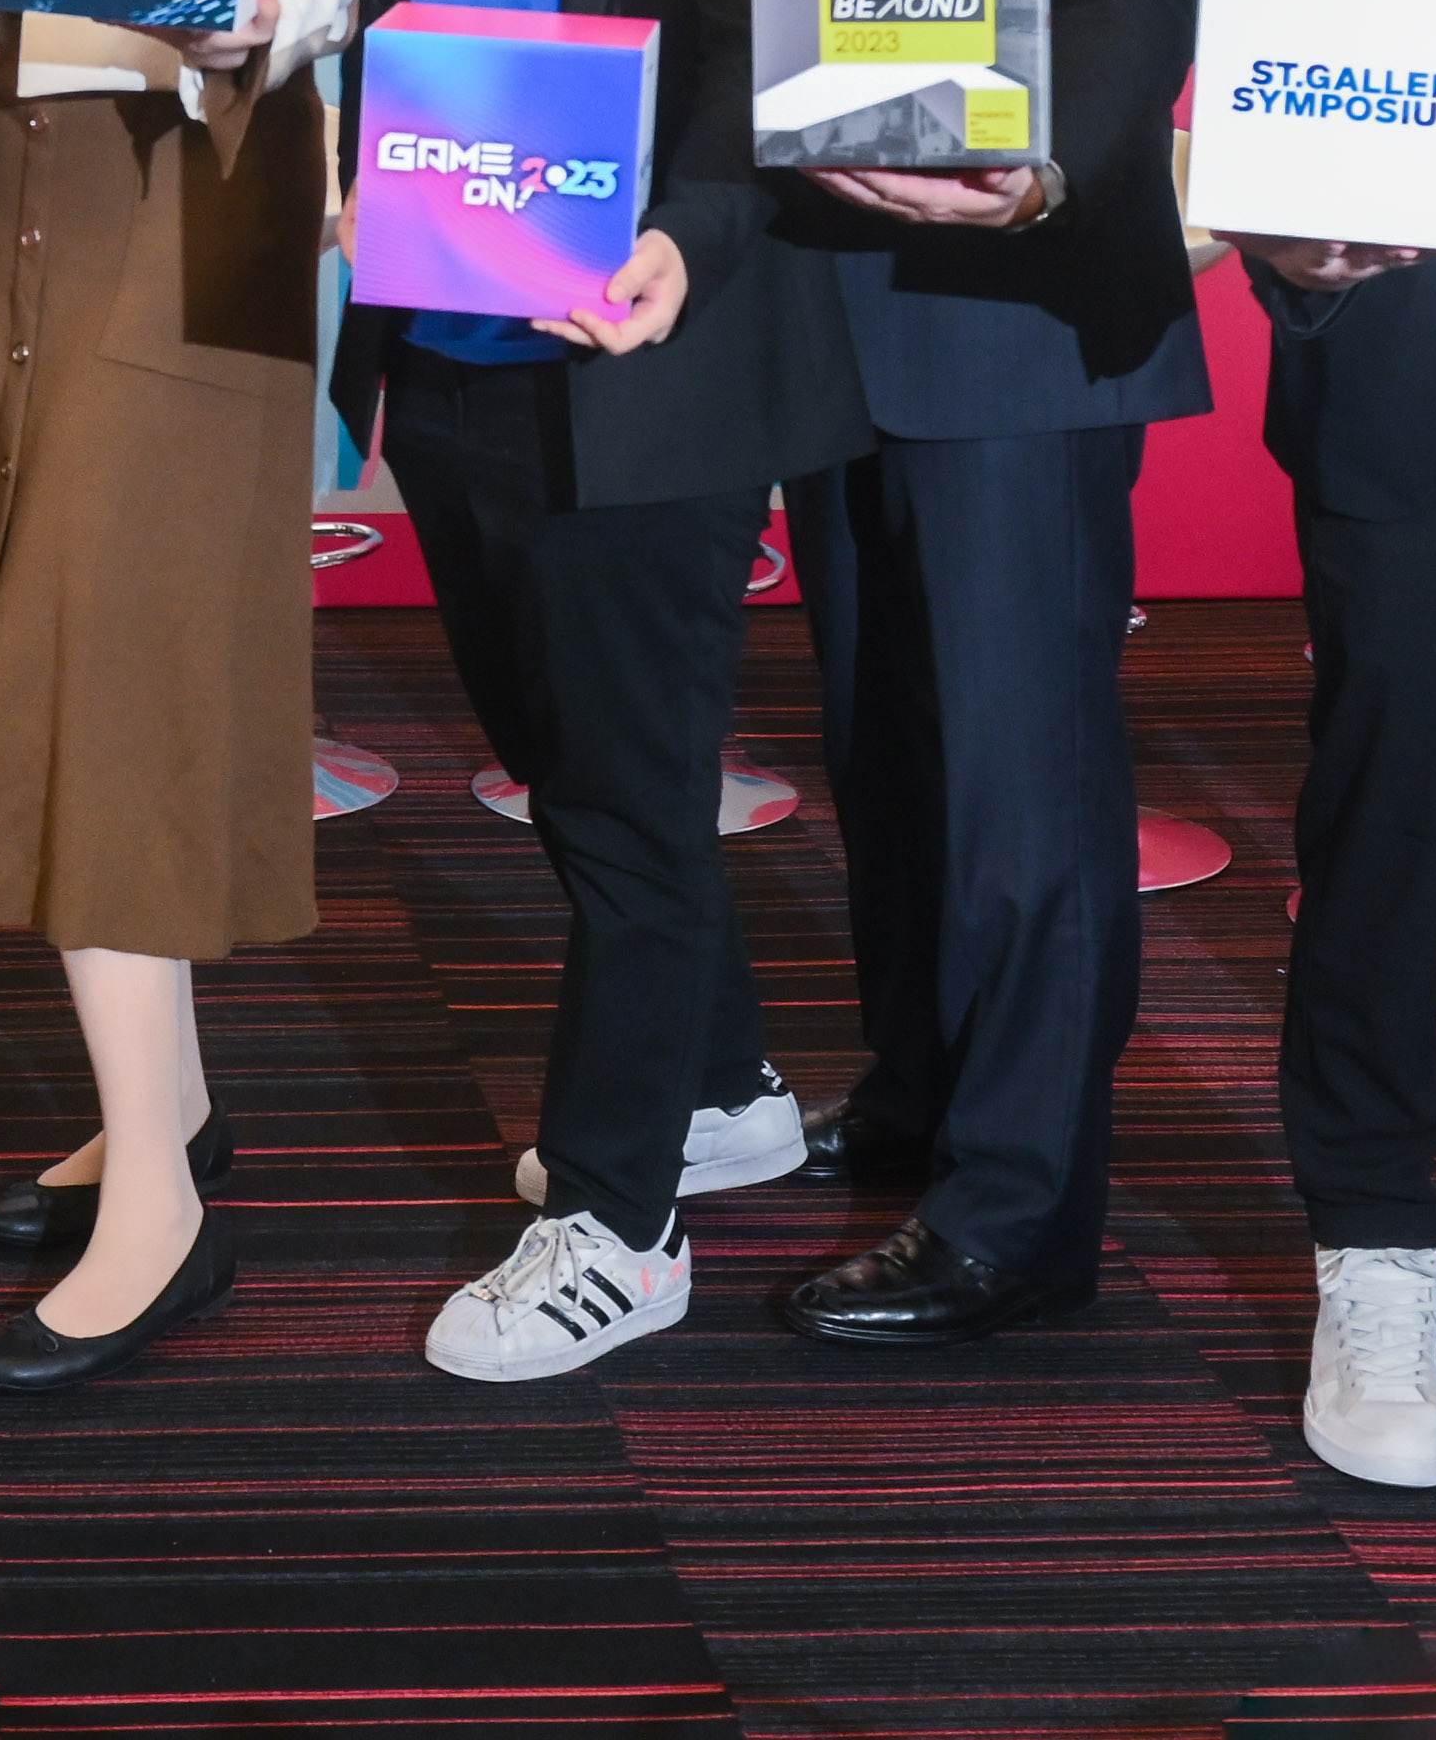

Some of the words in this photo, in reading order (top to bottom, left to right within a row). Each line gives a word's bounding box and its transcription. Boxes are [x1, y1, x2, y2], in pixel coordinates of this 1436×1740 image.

[834, 30, 901, 53] 2023
[377, 132, 514, 176] GAME
[463, 176, 535, 214] ON!
